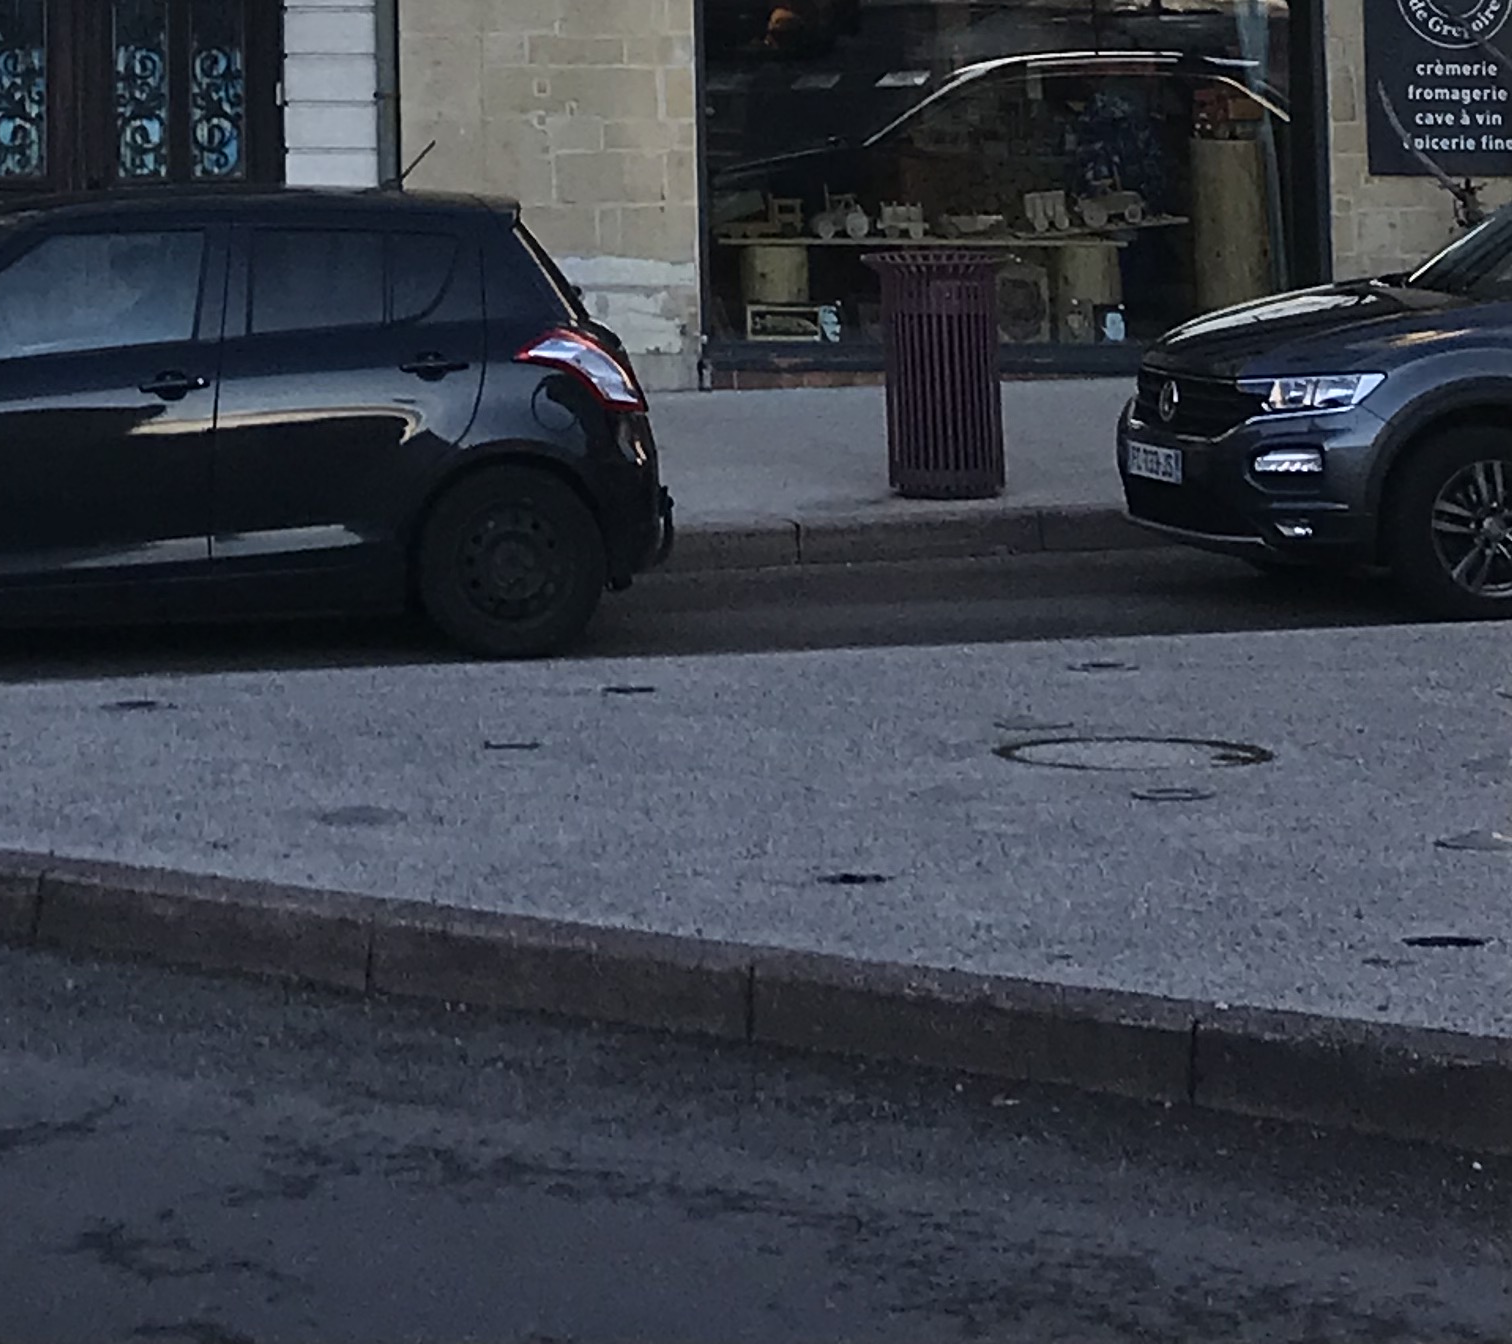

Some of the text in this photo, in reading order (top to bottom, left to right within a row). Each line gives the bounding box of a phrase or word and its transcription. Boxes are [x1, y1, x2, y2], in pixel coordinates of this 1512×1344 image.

[1416, 59, 1498, 76] crèmerie
[1408, 84, 1508, 104] fromagerie
[1415, 108, 1502, 125] cave à vin
